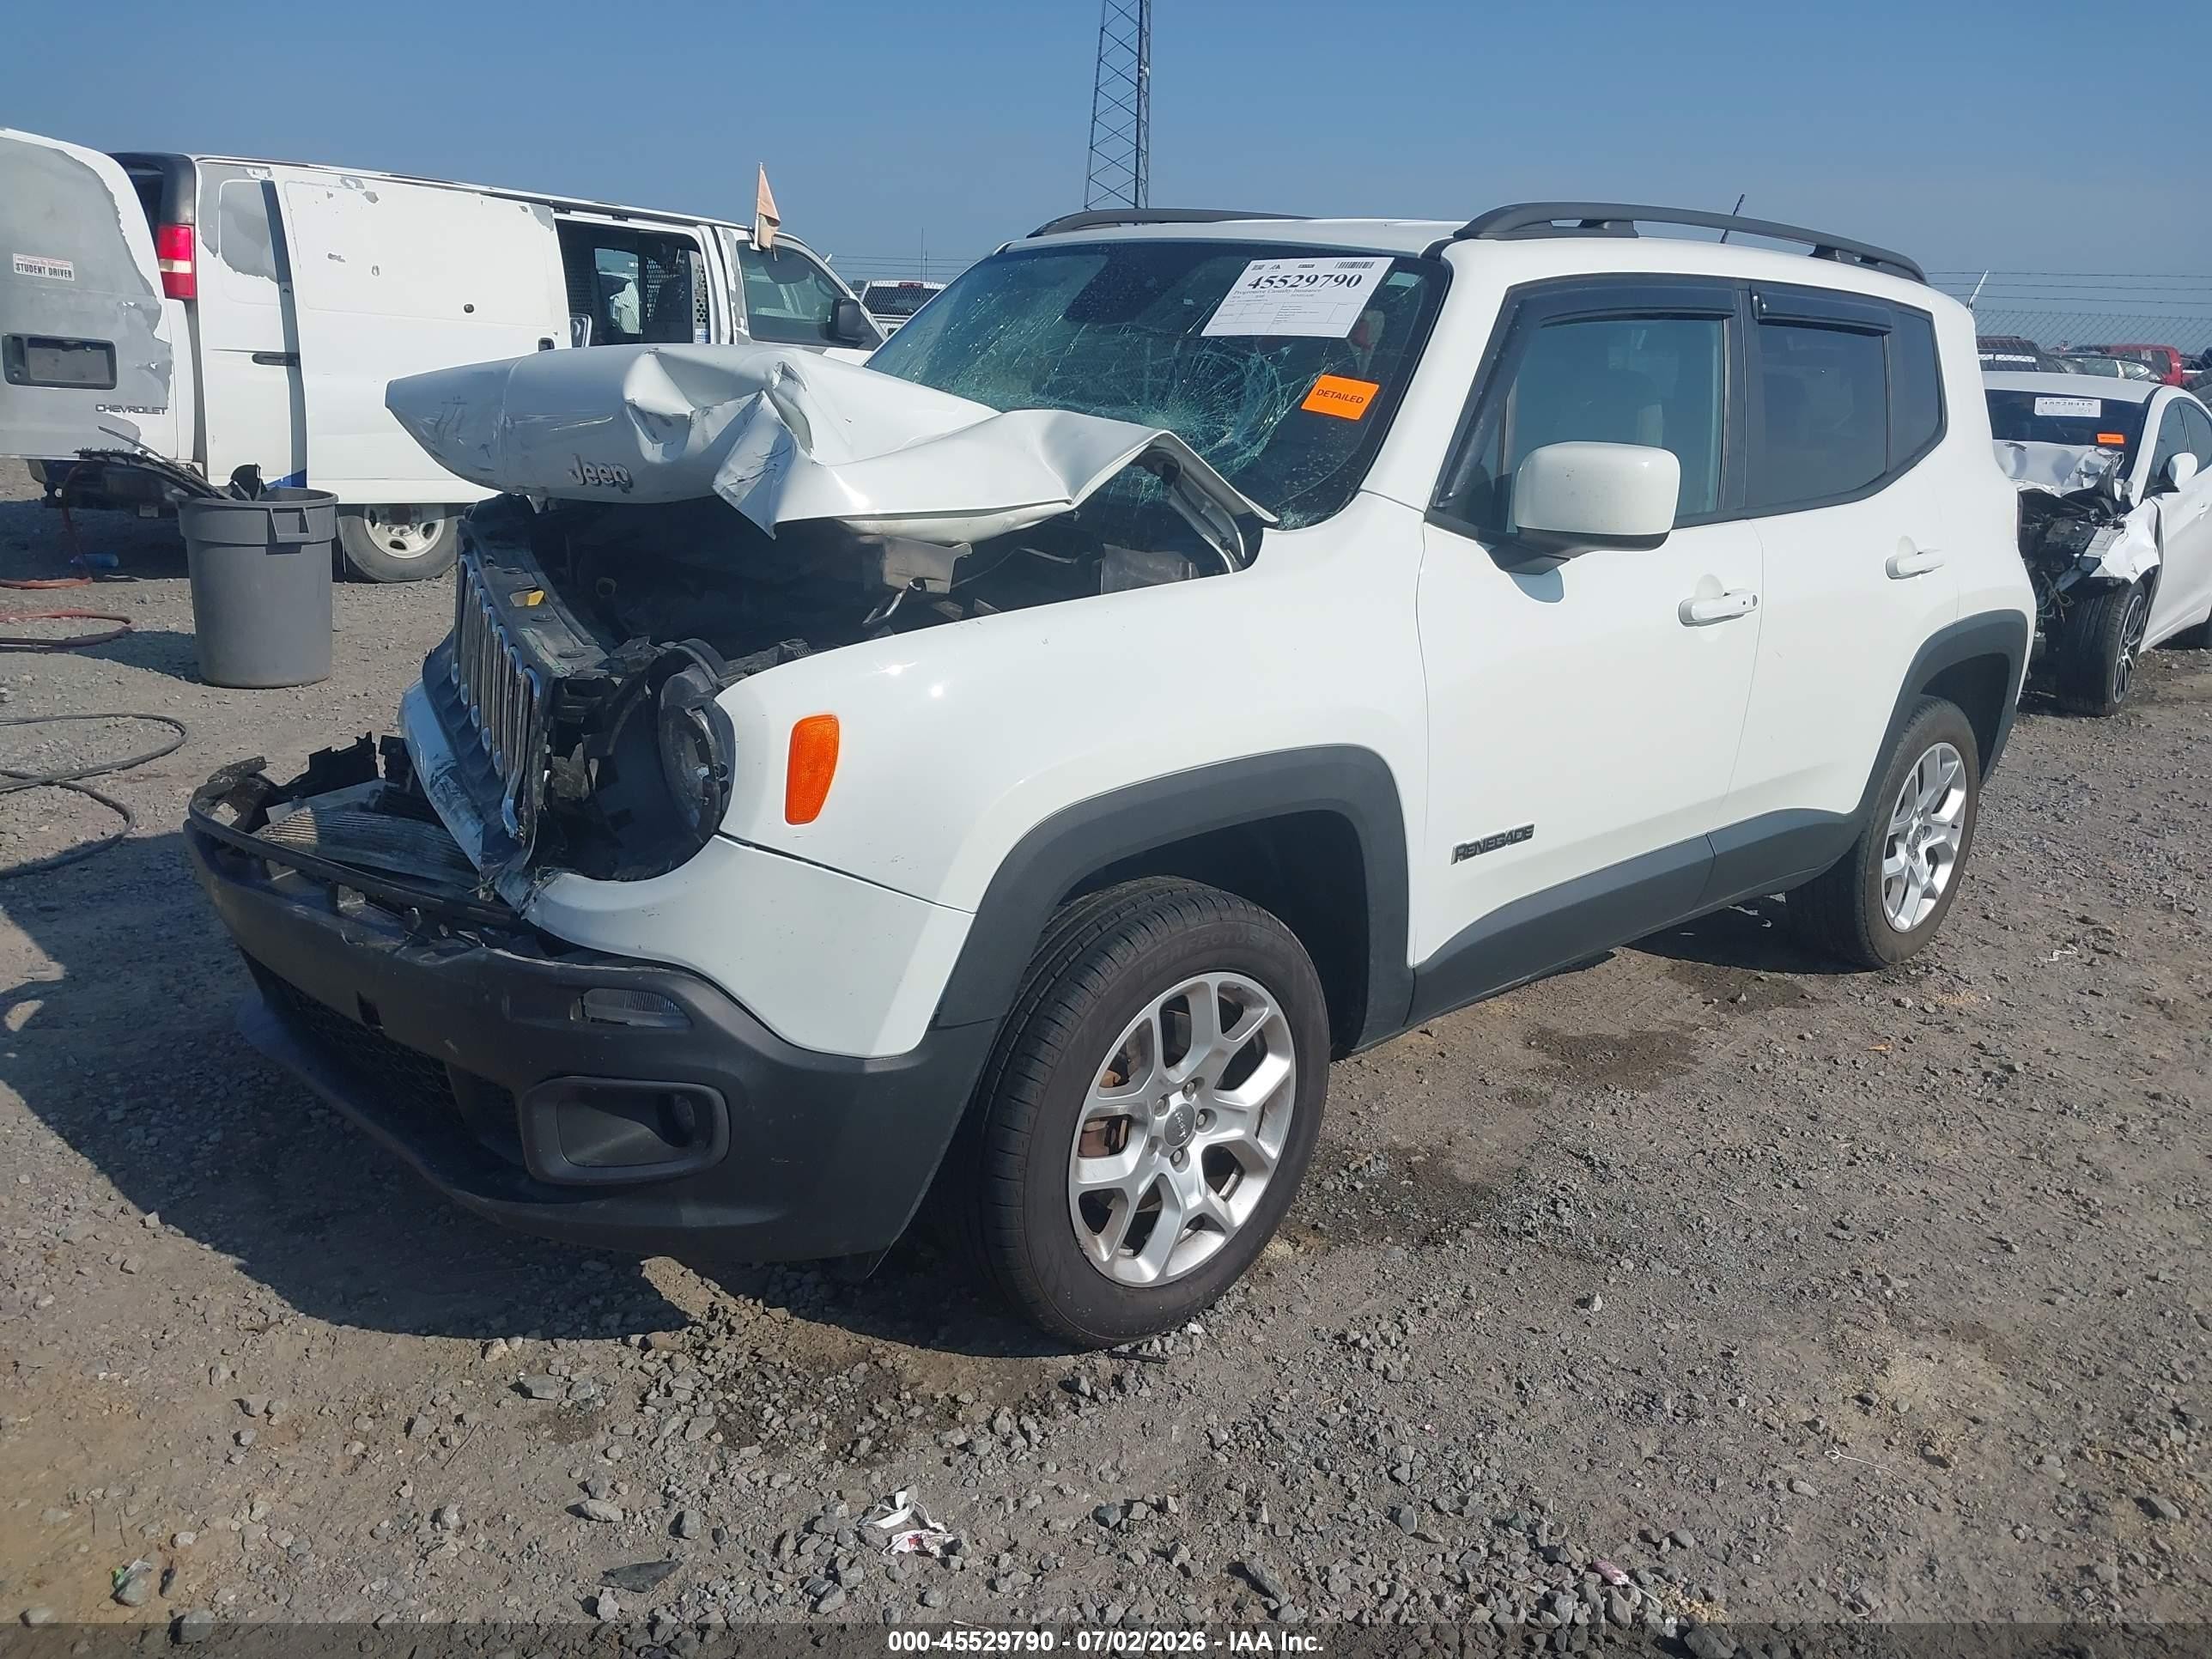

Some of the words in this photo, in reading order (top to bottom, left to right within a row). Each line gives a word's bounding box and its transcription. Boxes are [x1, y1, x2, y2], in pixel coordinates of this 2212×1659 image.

[15, 263, 46, 276] STUDENT
[48, 267, 72, 278] DRIVER
[1247, 273, 1363, 289] 45529790
[1316, 389, 1364, 404] DETAILED
[95, 404, 168, 416] CHEVROLET
[568, 453, 634, 494] Jeep
[1450, 823, 1535, 865] RENEGADE
